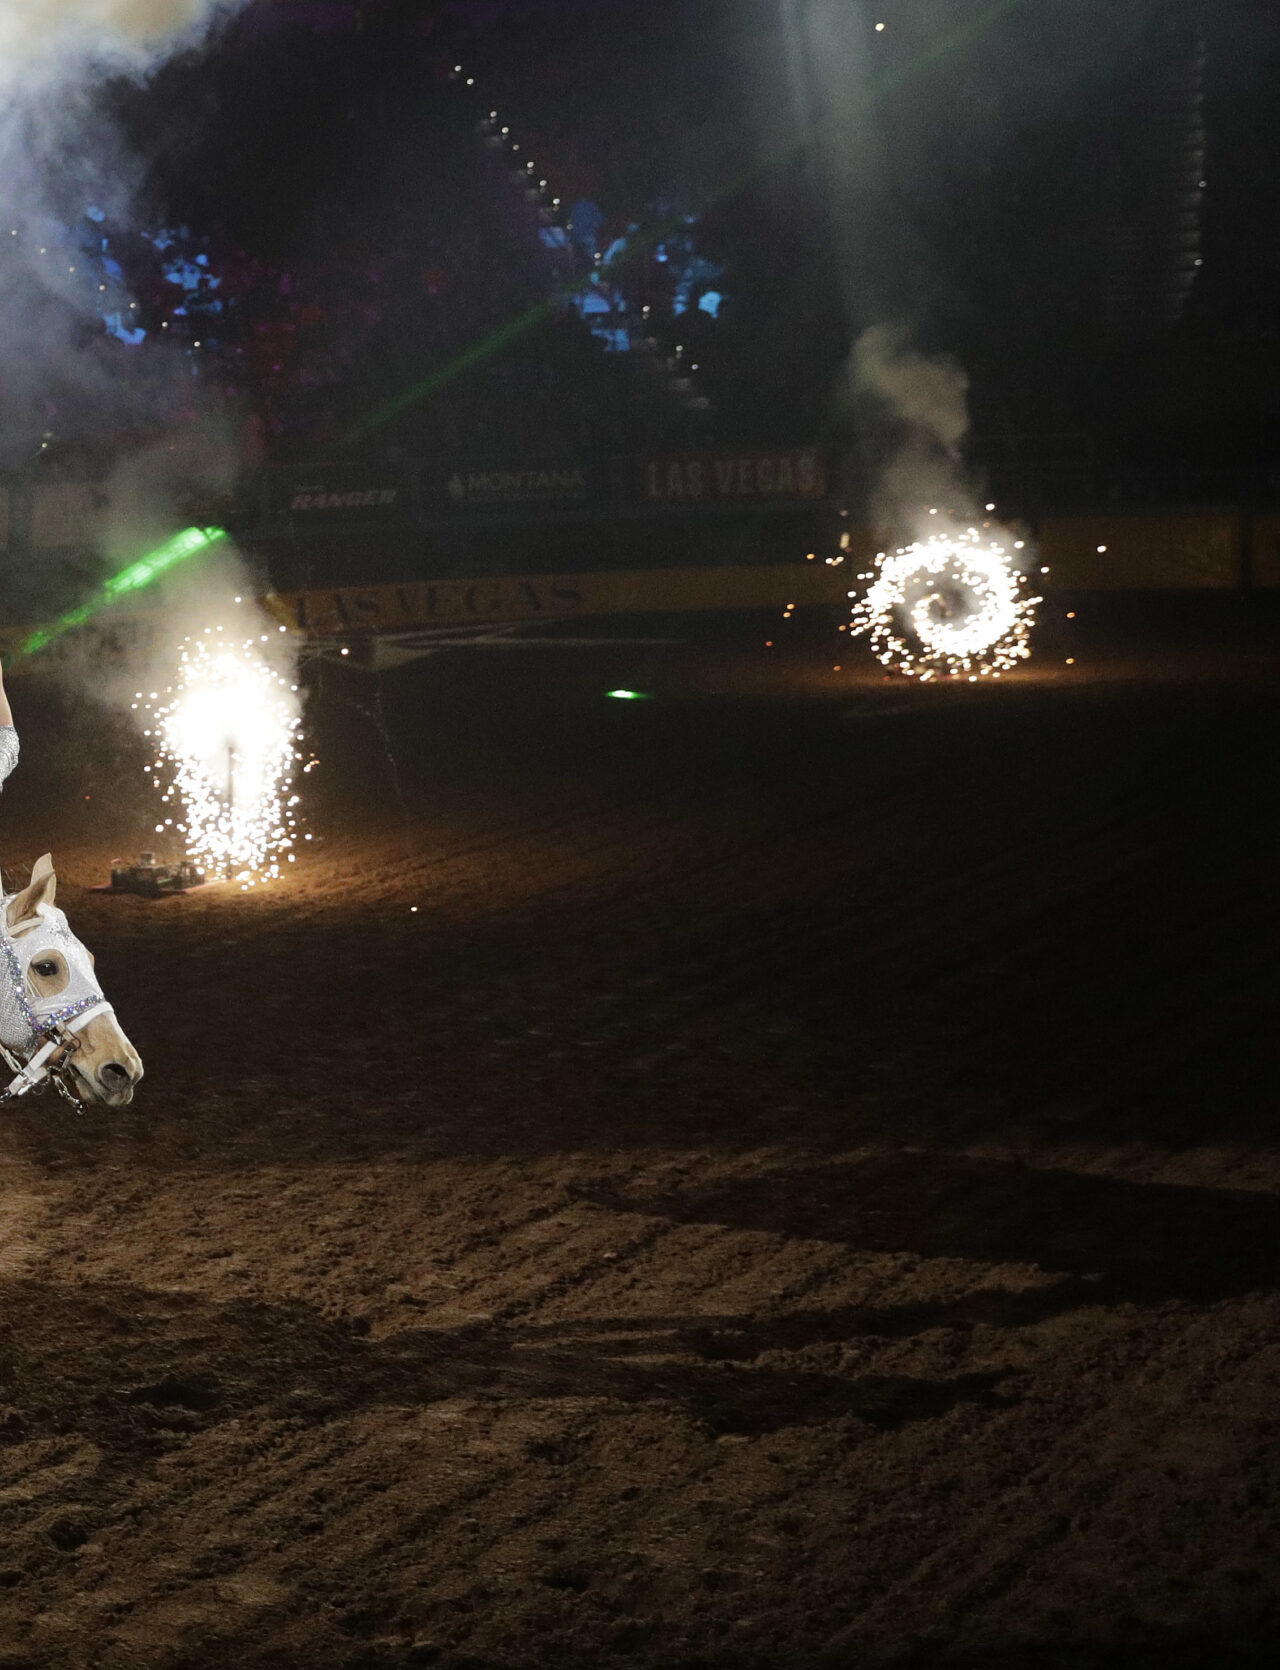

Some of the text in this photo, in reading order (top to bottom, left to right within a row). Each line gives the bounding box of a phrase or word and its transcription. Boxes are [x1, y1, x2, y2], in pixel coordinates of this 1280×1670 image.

[647, 454, 814, 498] LAS VEGAS
[390, 578, 584, 614] VEGAS
